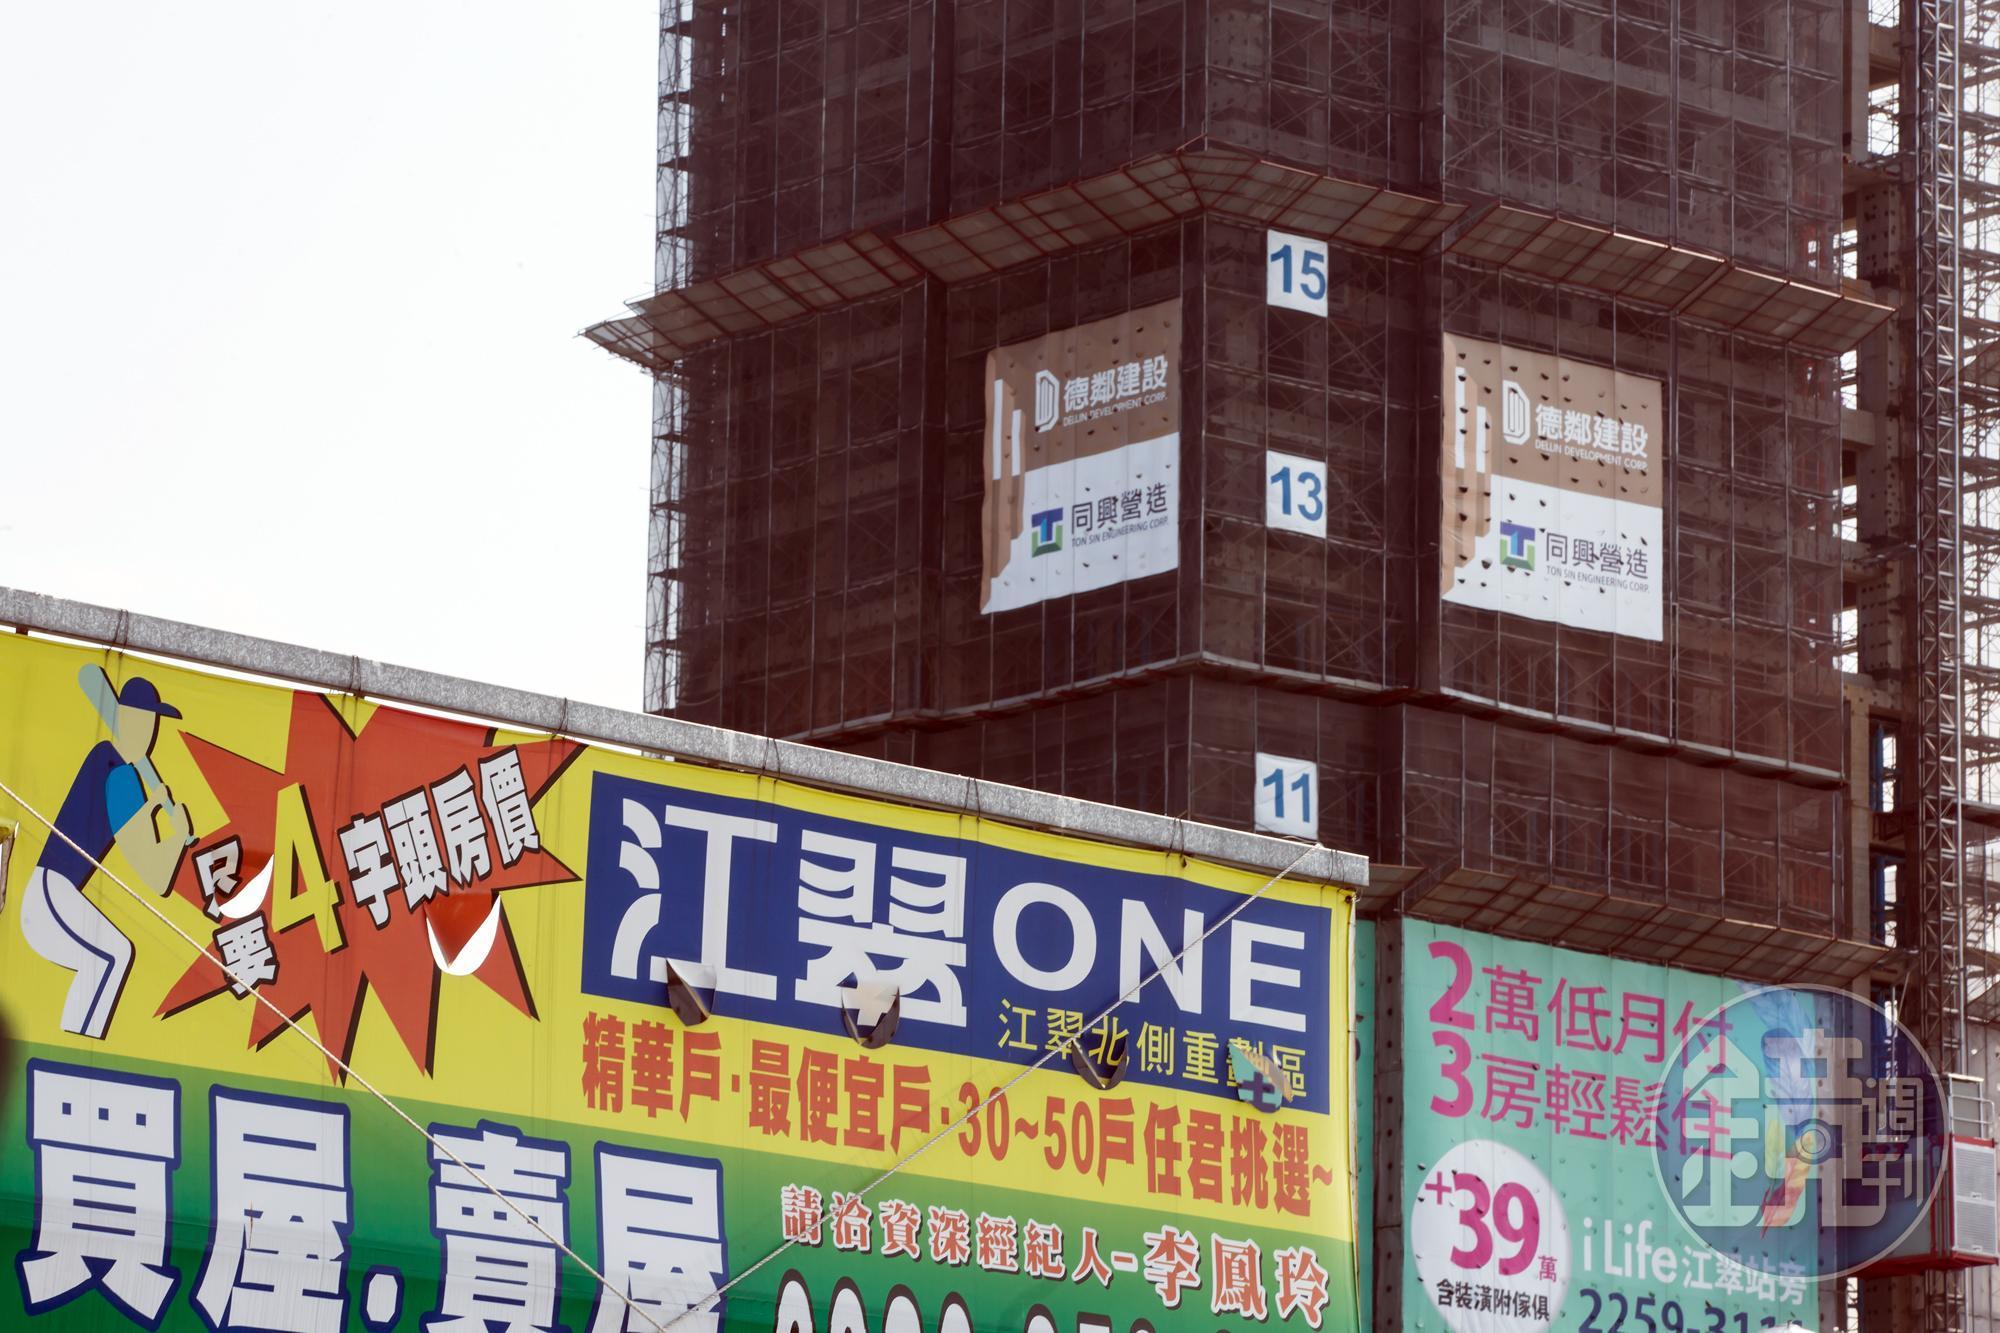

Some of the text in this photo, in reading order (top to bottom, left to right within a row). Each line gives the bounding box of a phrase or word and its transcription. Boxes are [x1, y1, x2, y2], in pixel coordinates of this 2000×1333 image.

[1269, 244, 1326, 301] 15
[1063, 355, 1169, 413] 德鄰建設
[1534, 439, 1563, 456] DELLIN
[1564, 444, 1623, 467] DEVELOPMENT
[1535, 403, 1649, 459] 德鄰建設
[1071, 482, 1168, 536] 同興營造
[1270, 466, 1323, 522] 13
[1071, 534, 1088, 549] TON
[1088, 531, 1101, 544] SIN
[1101, 519, 1148, 542] ENGINEERING
[1545, 532, 1649, 580] 同興營造
[1546, 565, 1563, 578] TON
[1563, 567, 1577, 581] SIN
[1577, 571, 1628, 591] ENGINEERING
[1262, 768, 1311, 823] 11
[338, 748, 541, 928] 字頭房價
[1427, 940, 1734, 1075] 2萬低月付
[1429, 1029, 1734, 1161] 3房輕鬆住
[1436, 1278, 1551, 1322] 含裝潢附傢俱
